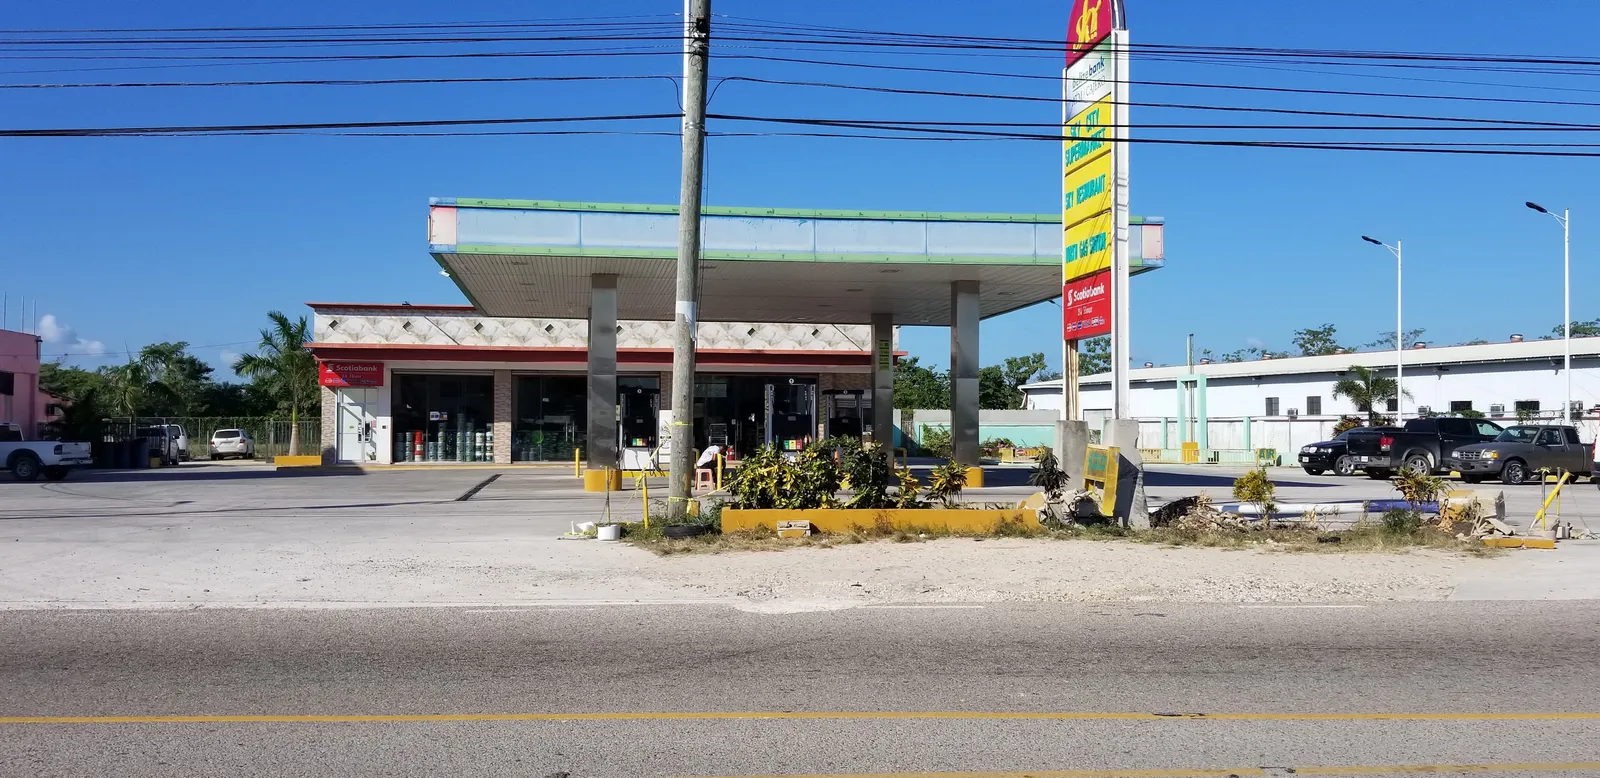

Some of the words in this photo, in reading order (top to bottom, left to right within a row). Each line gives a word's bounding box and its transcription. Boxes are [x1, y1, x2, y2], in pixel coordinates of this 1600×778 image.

[1086, 108, 1099, 132] CITY
[1073, 282, 1105, 302] Scotiabank
[336, 364, 378, 372] Scotiabank
